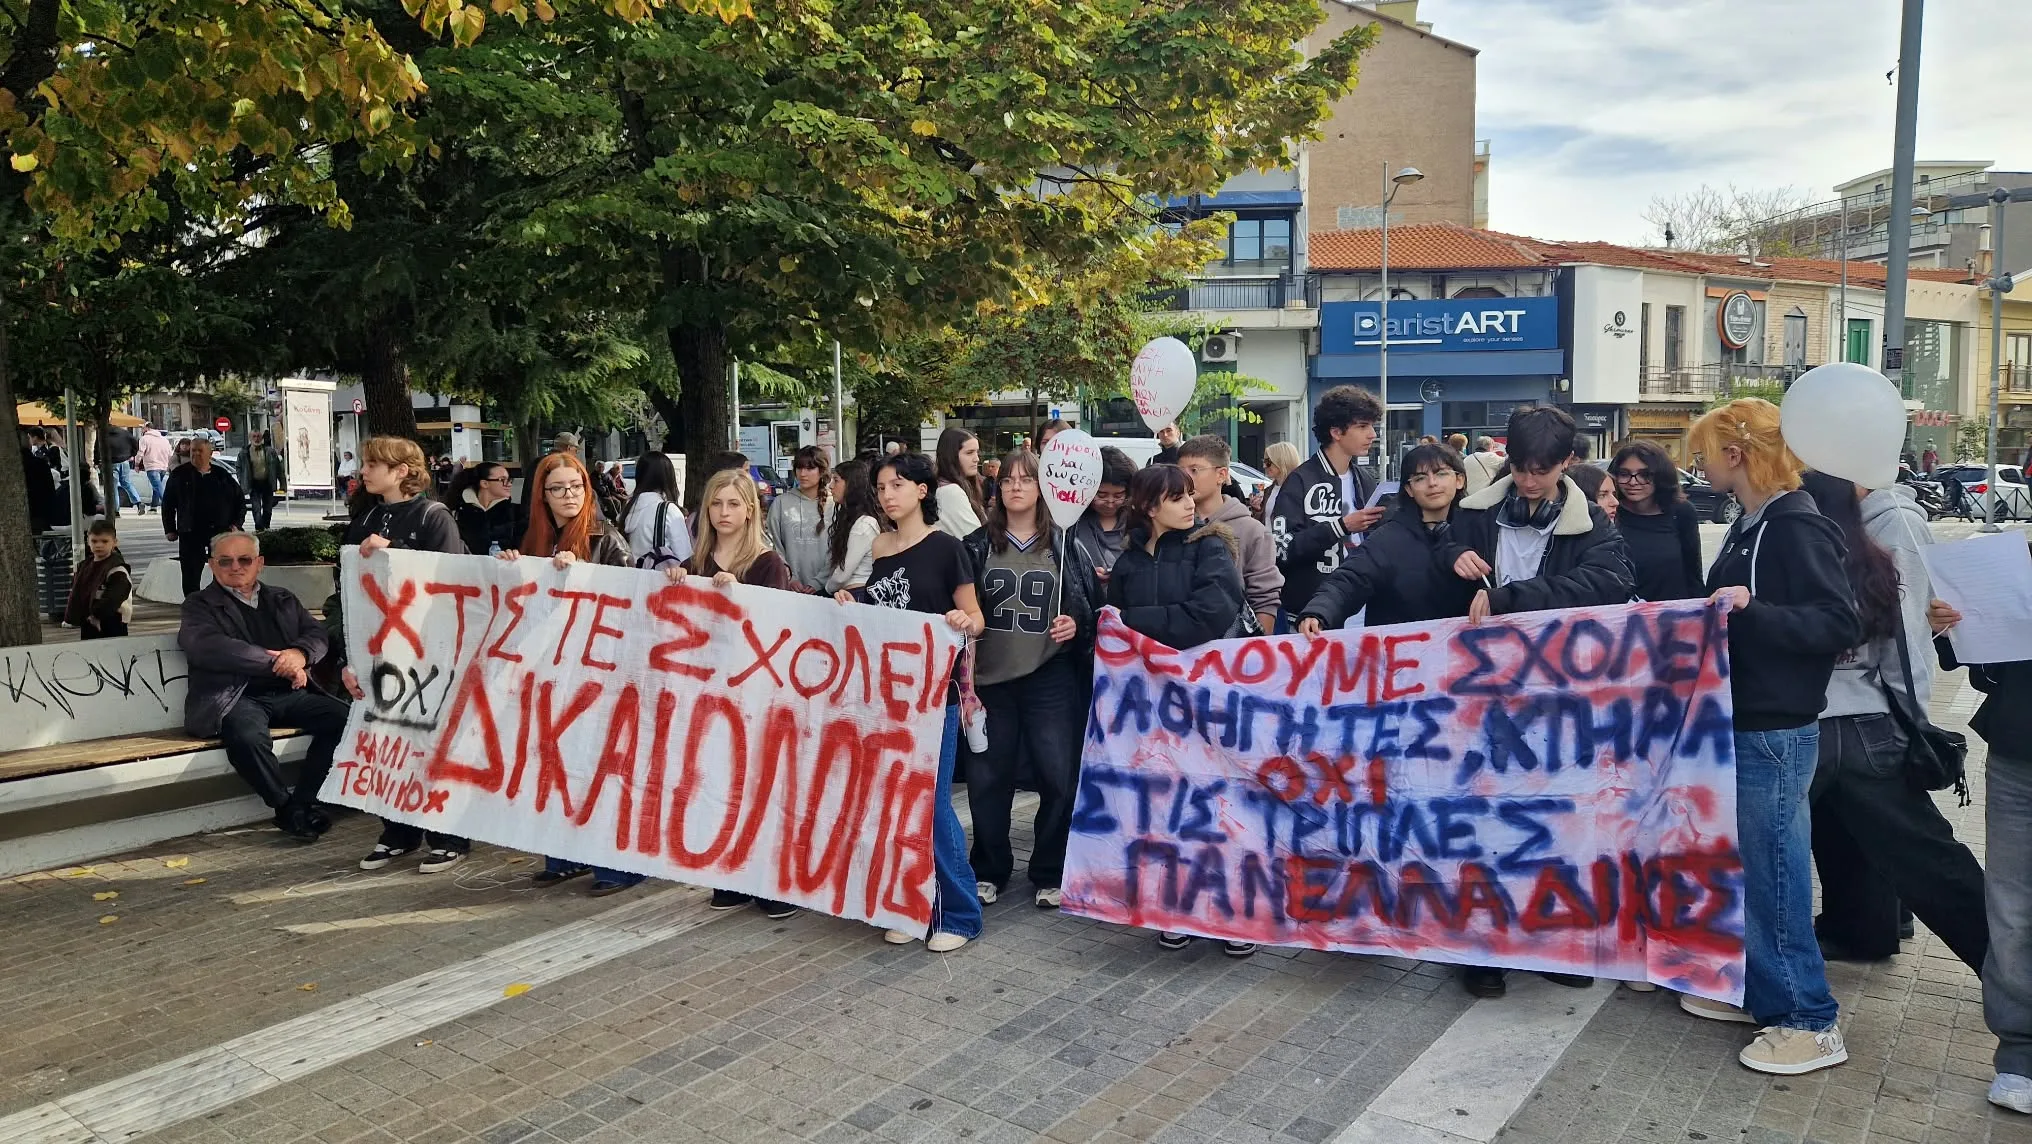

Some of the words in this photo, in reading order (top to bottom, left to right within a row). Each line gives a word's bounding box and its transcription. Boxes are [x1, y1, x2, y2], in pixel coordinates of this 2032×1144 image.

[1354, 310, 1526, 337] BaristART
[984, 567, 1056, 635] 29
[371, 662, 456, 720] ΟΧΙ
[1256, 751, 1386, 806] ΟΧΙ
[1071, 762, 1228, 844] ΣΤΙΣ
[1238, 786, 1576, 876] ΤΡΙΠΛΕΣ
